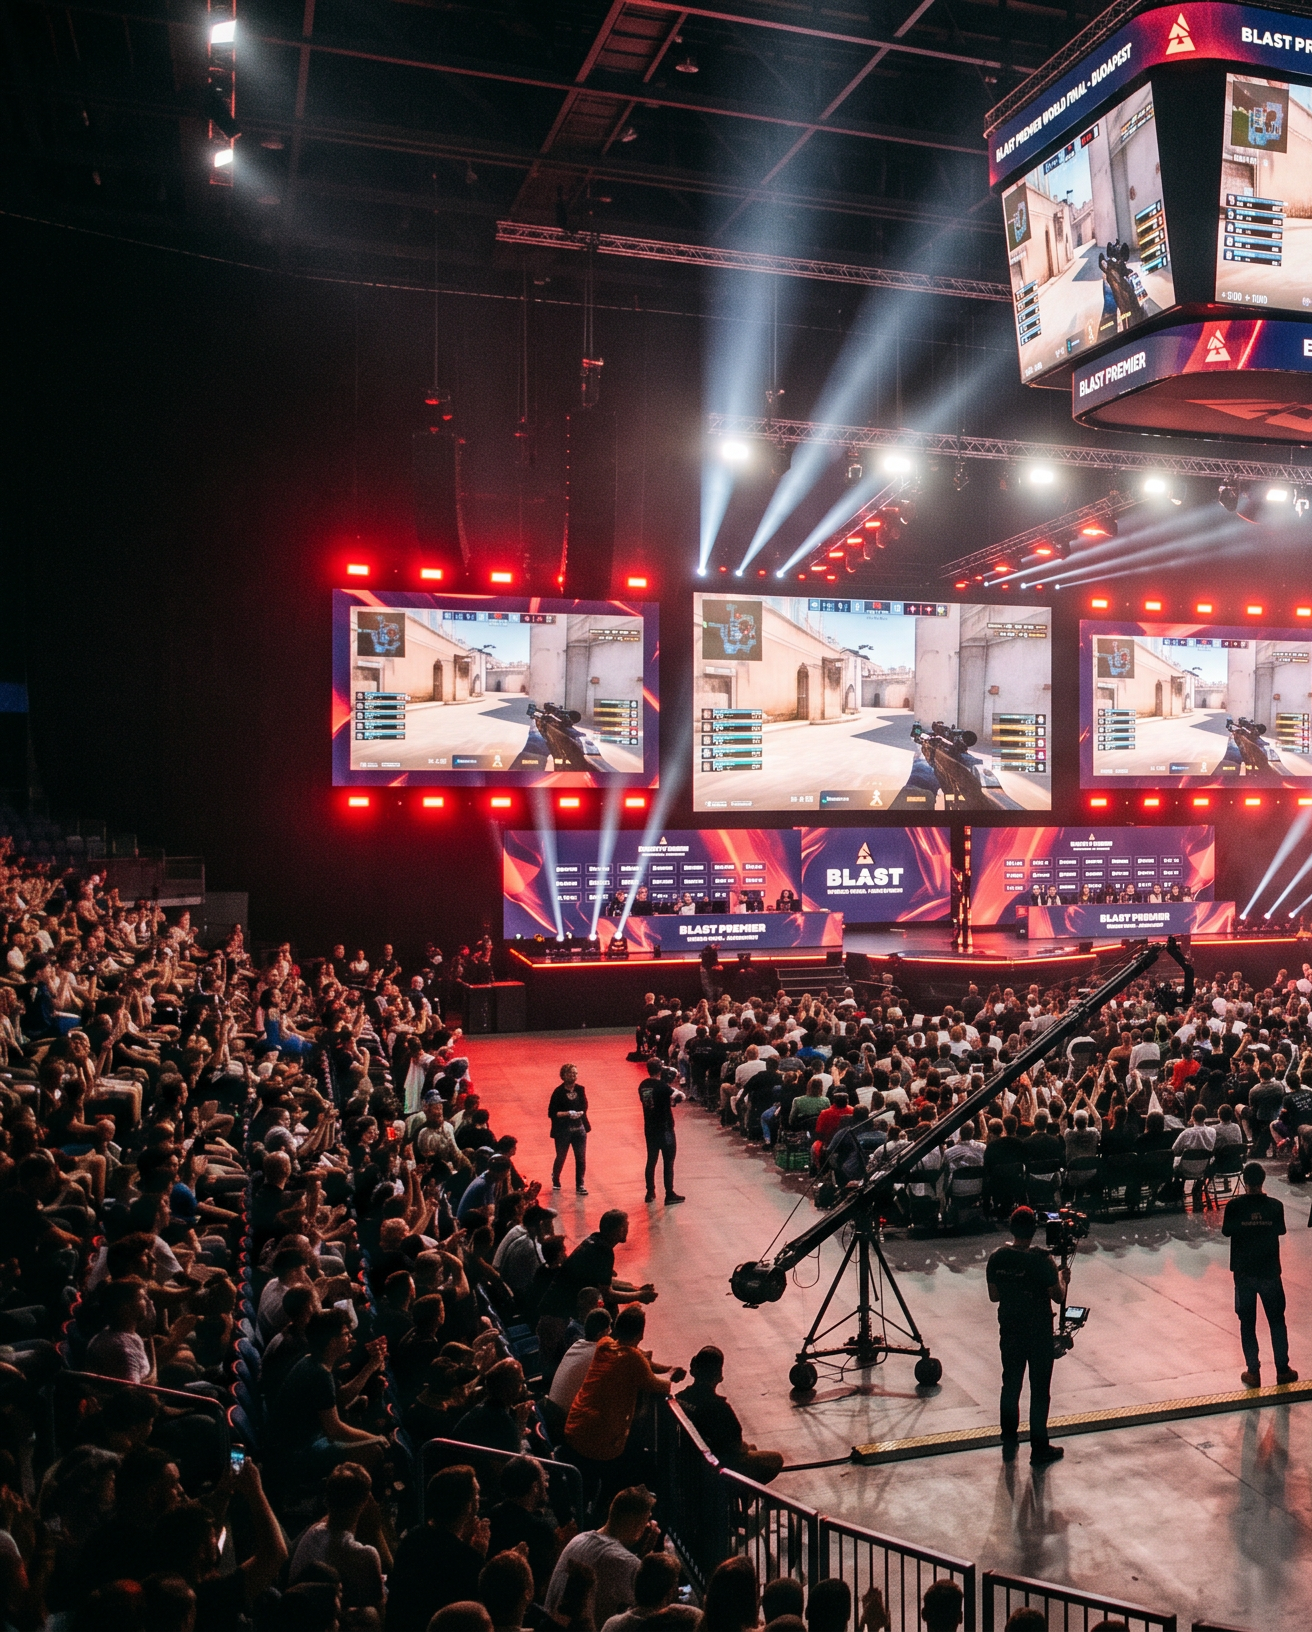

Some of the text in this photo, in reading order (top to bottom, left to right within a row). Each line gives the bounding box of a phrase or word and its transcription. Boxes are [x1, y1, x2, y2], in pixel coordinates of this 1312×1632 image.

[1241, 27, 1292, 50] BLAST
[1079, 352, 1146, 397] BLAST PREMIER
[826, 867, 904, 887] BLAST
[1100, 913, 1131, 923] BLAST
[679, 924, 718, 935] BLAST
